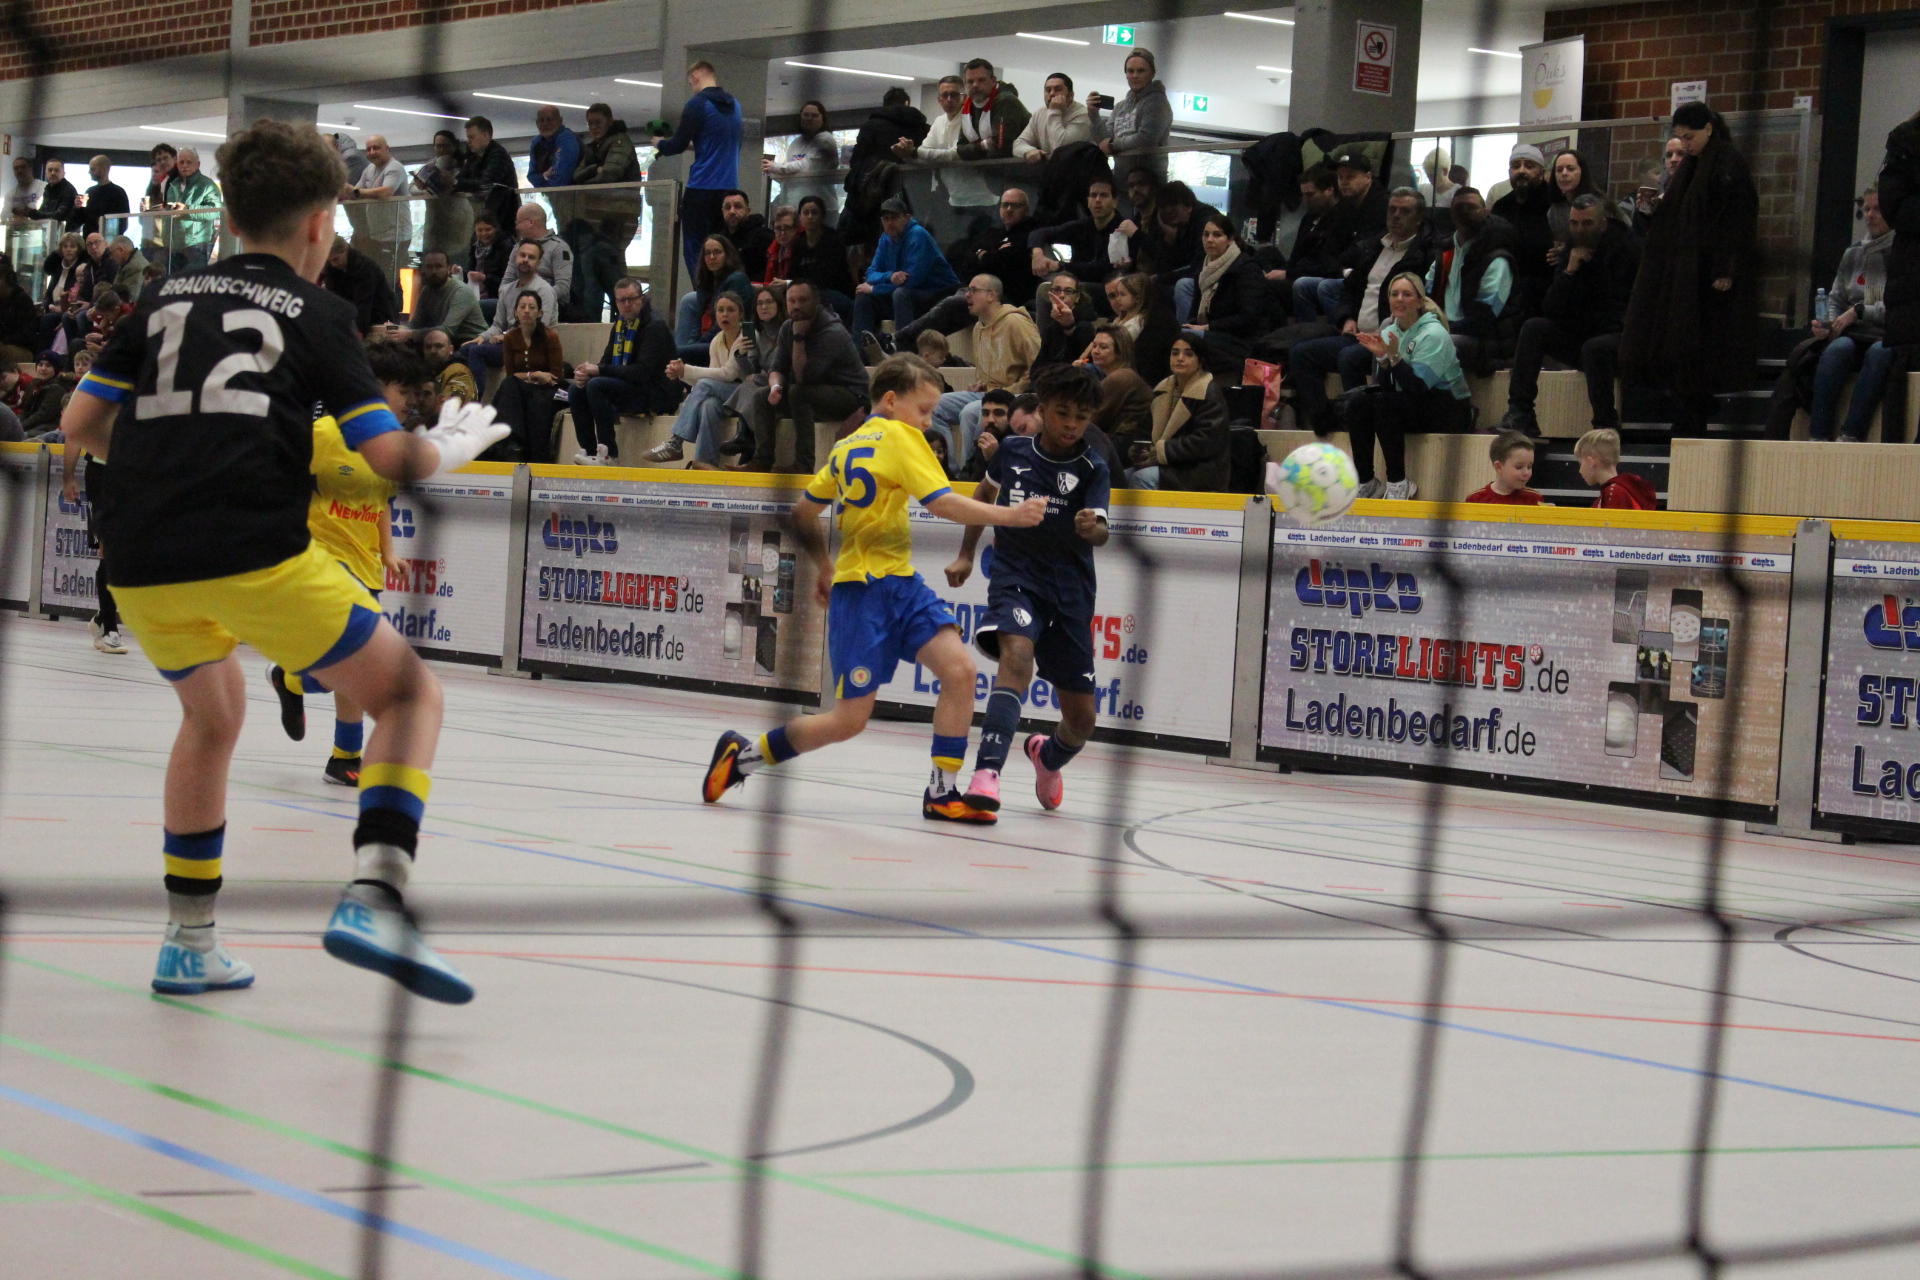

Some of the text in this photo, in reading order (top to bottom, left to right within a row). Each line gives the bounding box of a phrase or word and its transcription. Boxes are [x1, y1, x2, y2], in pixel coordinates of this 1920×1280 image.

[159, 276, 304, 319] BRAUNSCHWEIG
[135, 301, 285, 420] 12
[1310, 533, 1355, 544] Ladenbedarf
[1453, 541, 1503, 552] Ladenbedarf
[1609, 549, 1664, 561] Ladenbedarf
[1883, 565, 1920, 576] Ladenb
